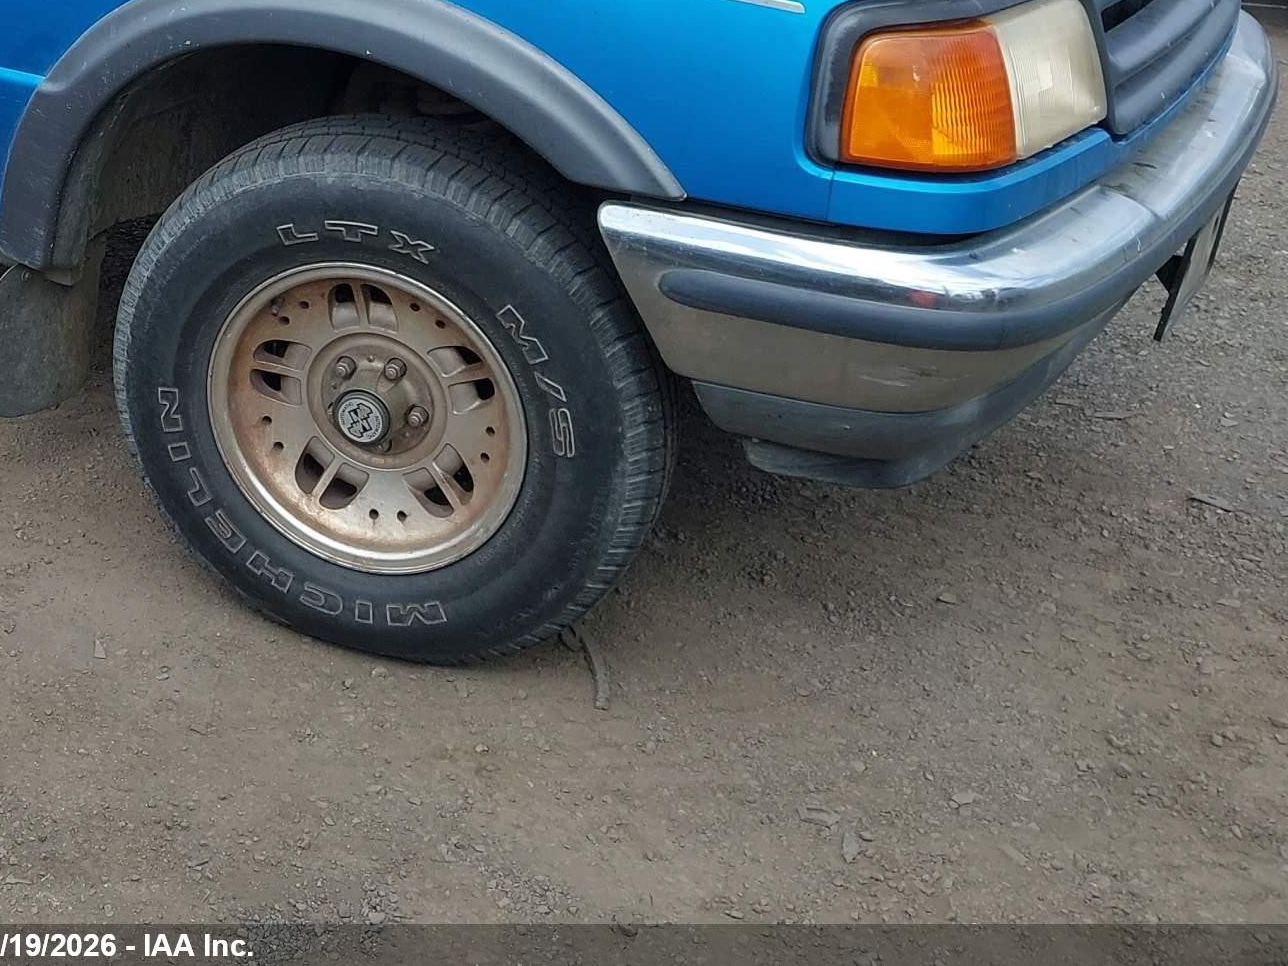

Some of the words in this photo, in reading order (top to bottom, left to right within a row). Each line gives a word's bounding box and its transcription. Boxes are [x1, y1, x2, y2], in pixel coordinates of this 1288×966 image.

[276, 220, 438, 265] LTX
[495, 305, 576, 458] M/S
[157, 387, 448, 627] MICHELIN
